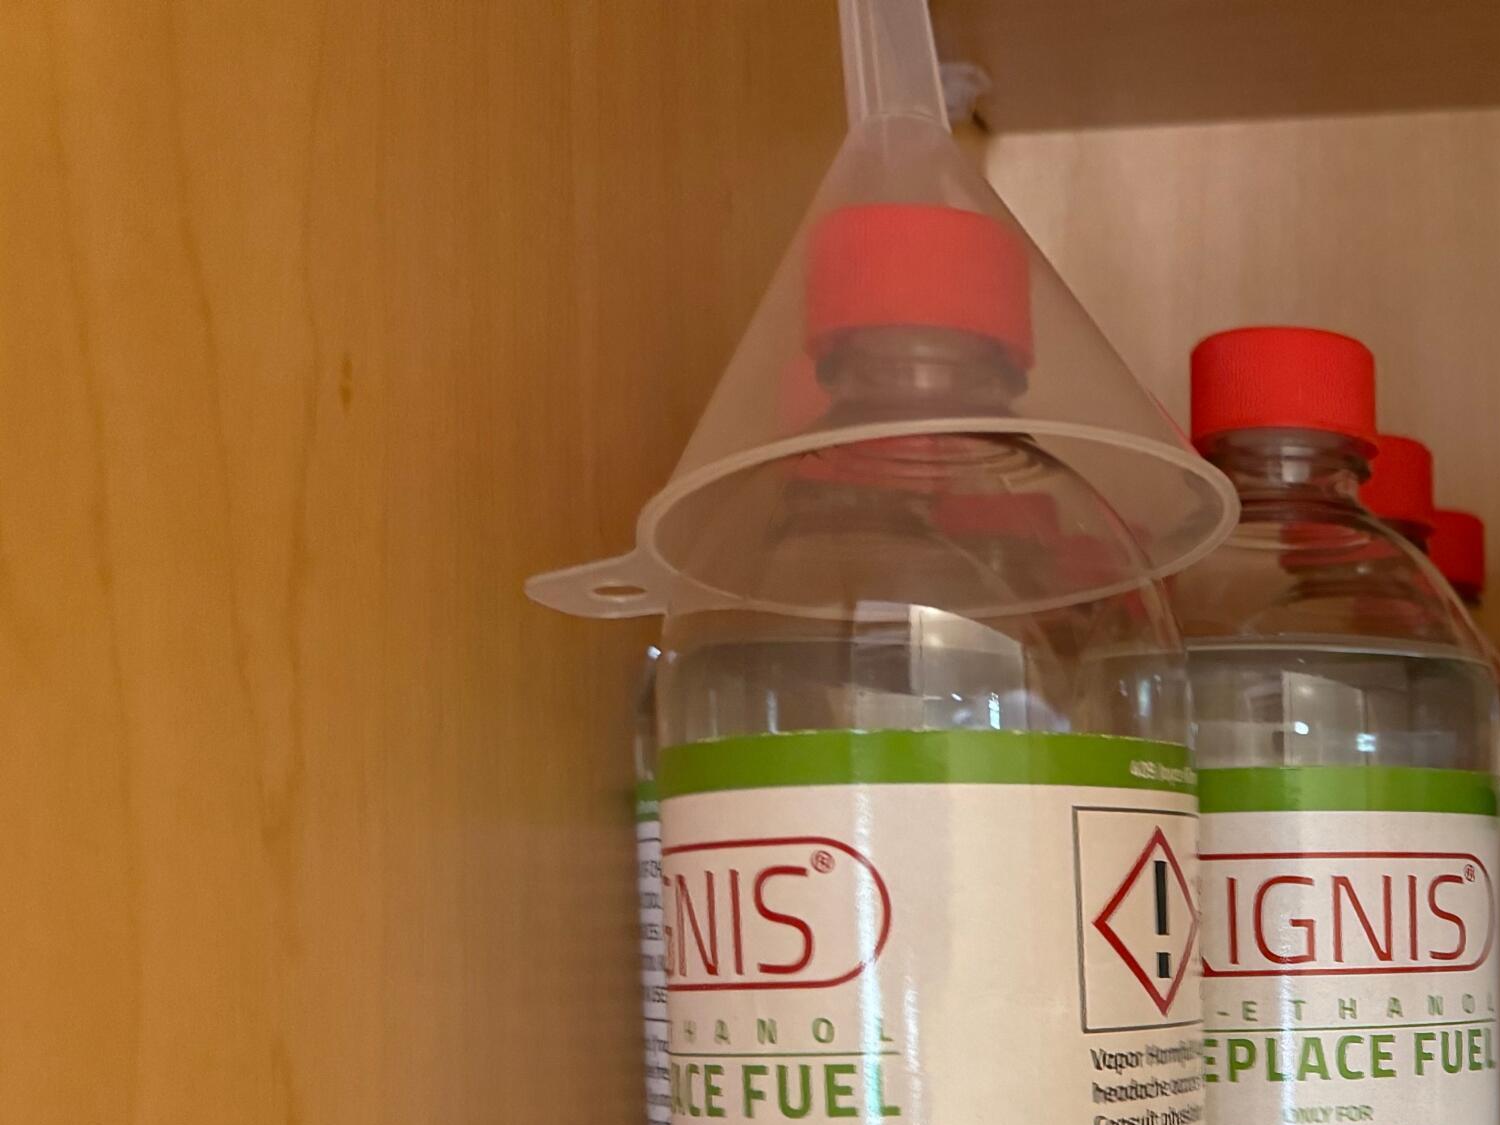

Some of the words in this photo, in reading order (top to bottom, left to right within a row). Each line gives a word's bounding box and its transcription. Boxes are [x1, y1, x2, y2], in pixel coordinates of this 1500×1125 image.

[1413, 1028, 1496, 1077] FUEL
[741, 1062, 901, 1119] FUEL
[1335, 1104, 1375, 1123] FOR
